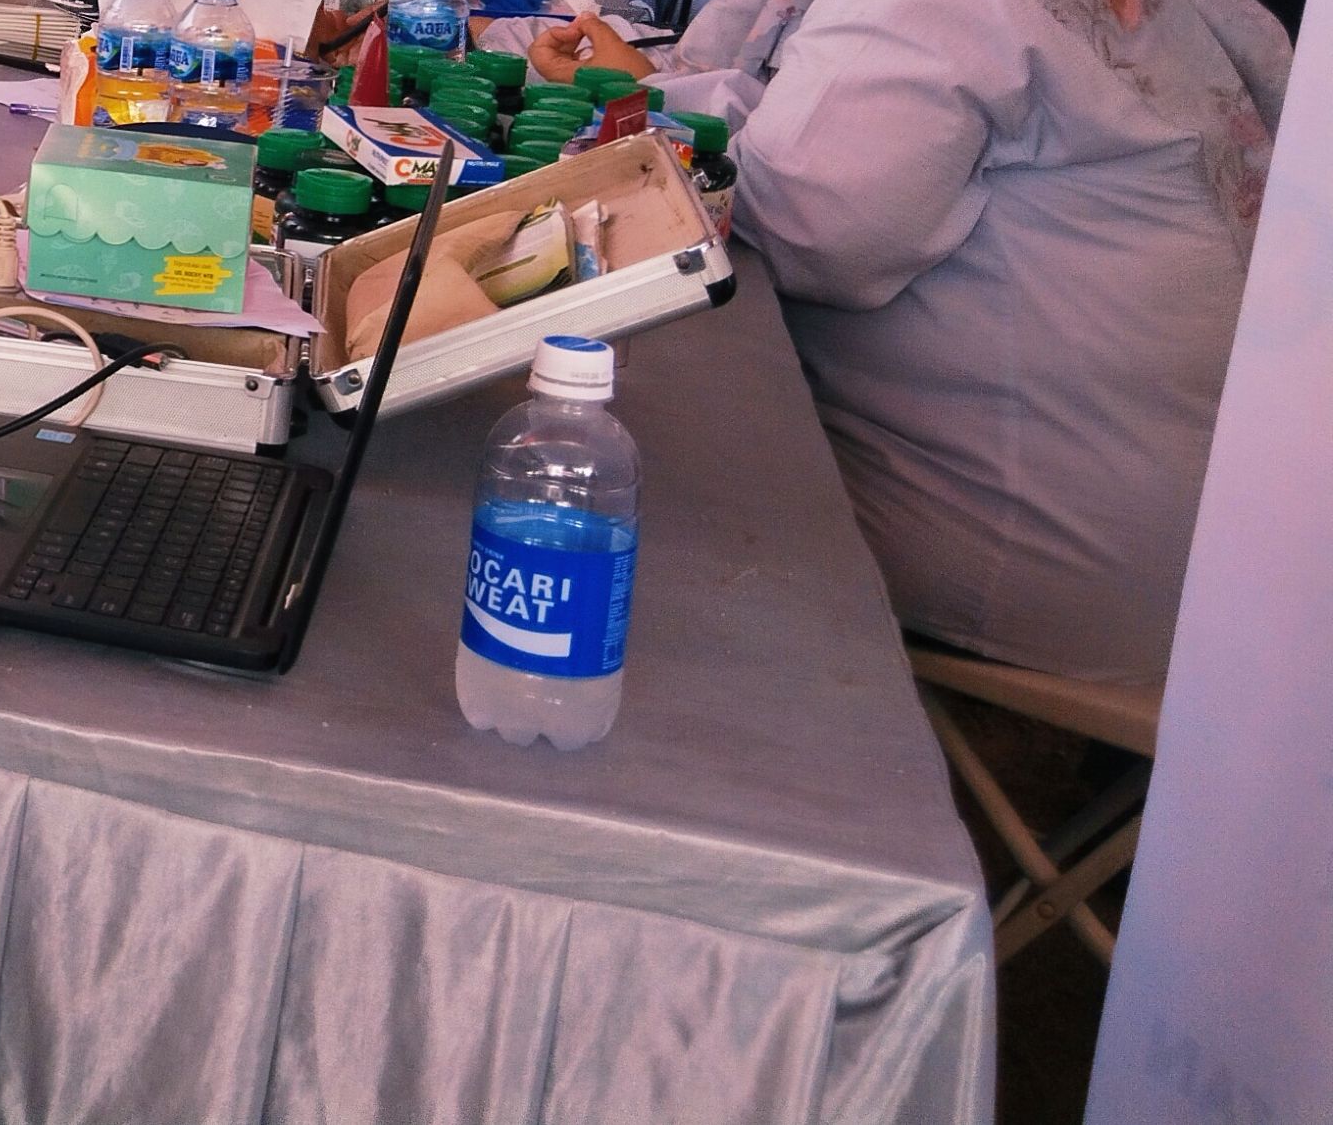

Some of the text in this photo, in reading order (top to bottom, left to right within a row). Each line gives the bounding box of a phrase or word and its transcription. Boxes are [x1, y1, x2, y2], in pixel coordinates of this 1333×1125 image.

[413, 21, 453, 40] AQUA
[467, 573, 555, 624] WEAT
[470, 550, 571, 602] OCARI
